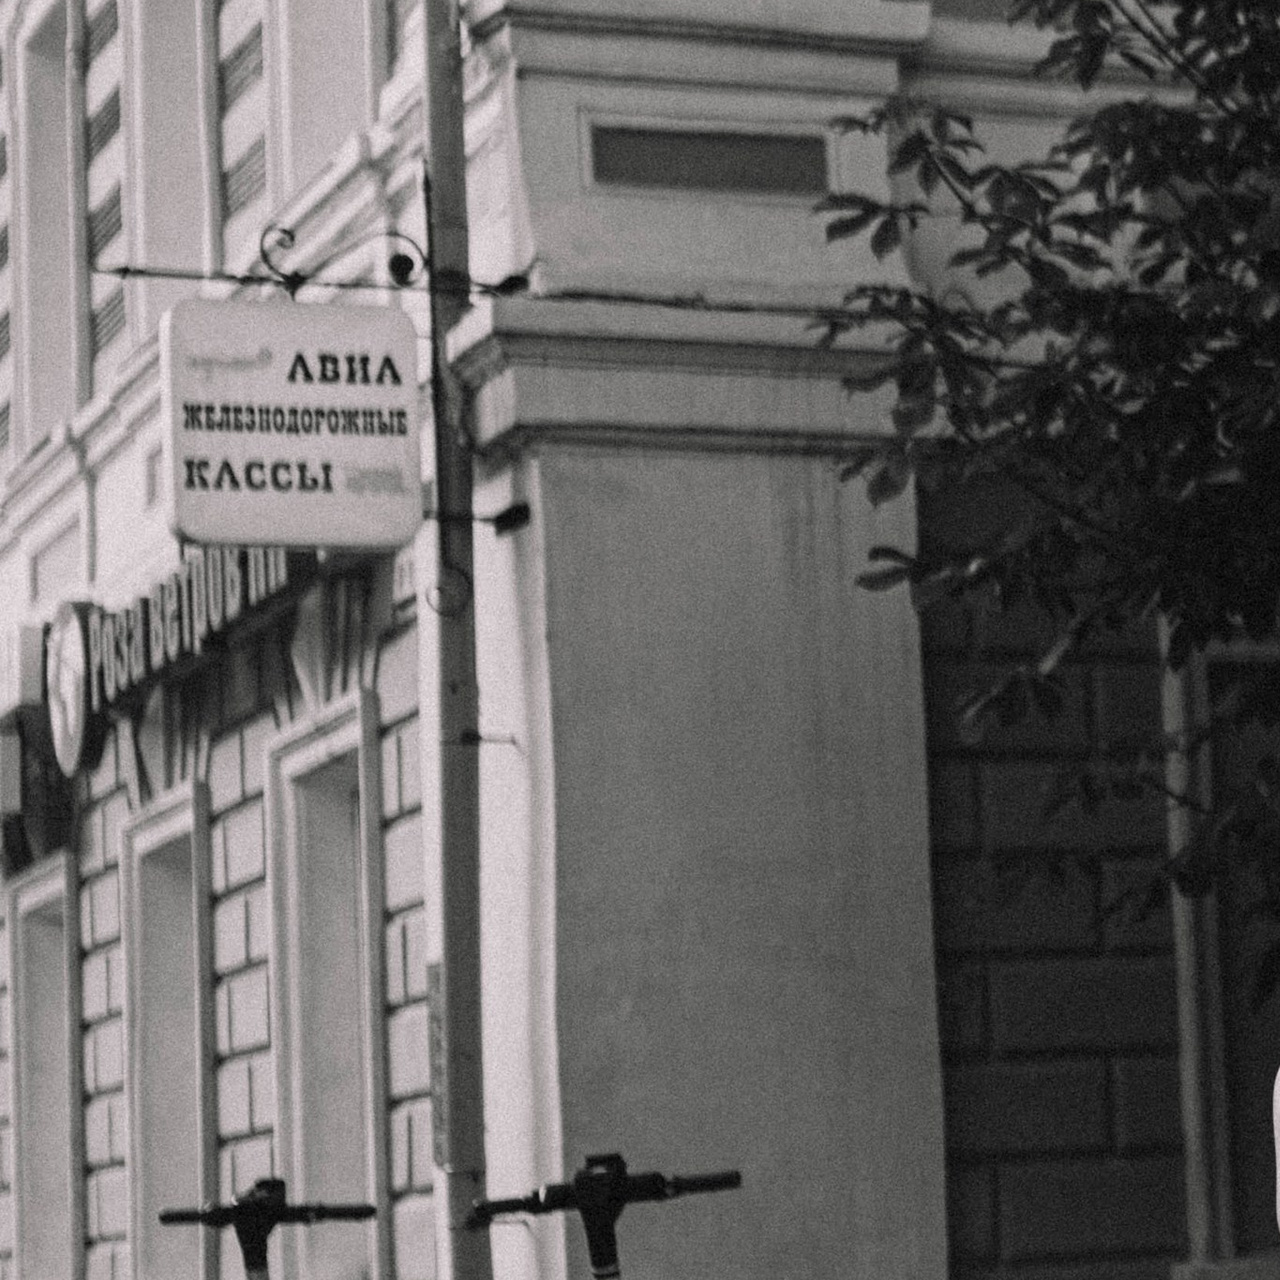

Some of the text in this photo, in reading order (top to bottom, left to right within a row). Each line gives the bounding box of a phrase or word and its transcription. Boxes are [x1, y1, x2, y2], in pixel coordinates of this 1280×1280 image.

[287, 352, 402, 385] АВИА
[183, 403, 408, 436] ЖЕЛЕЗНОДОРОЖНЫЕ
[183, 459, 334, 494] КАССЫ
